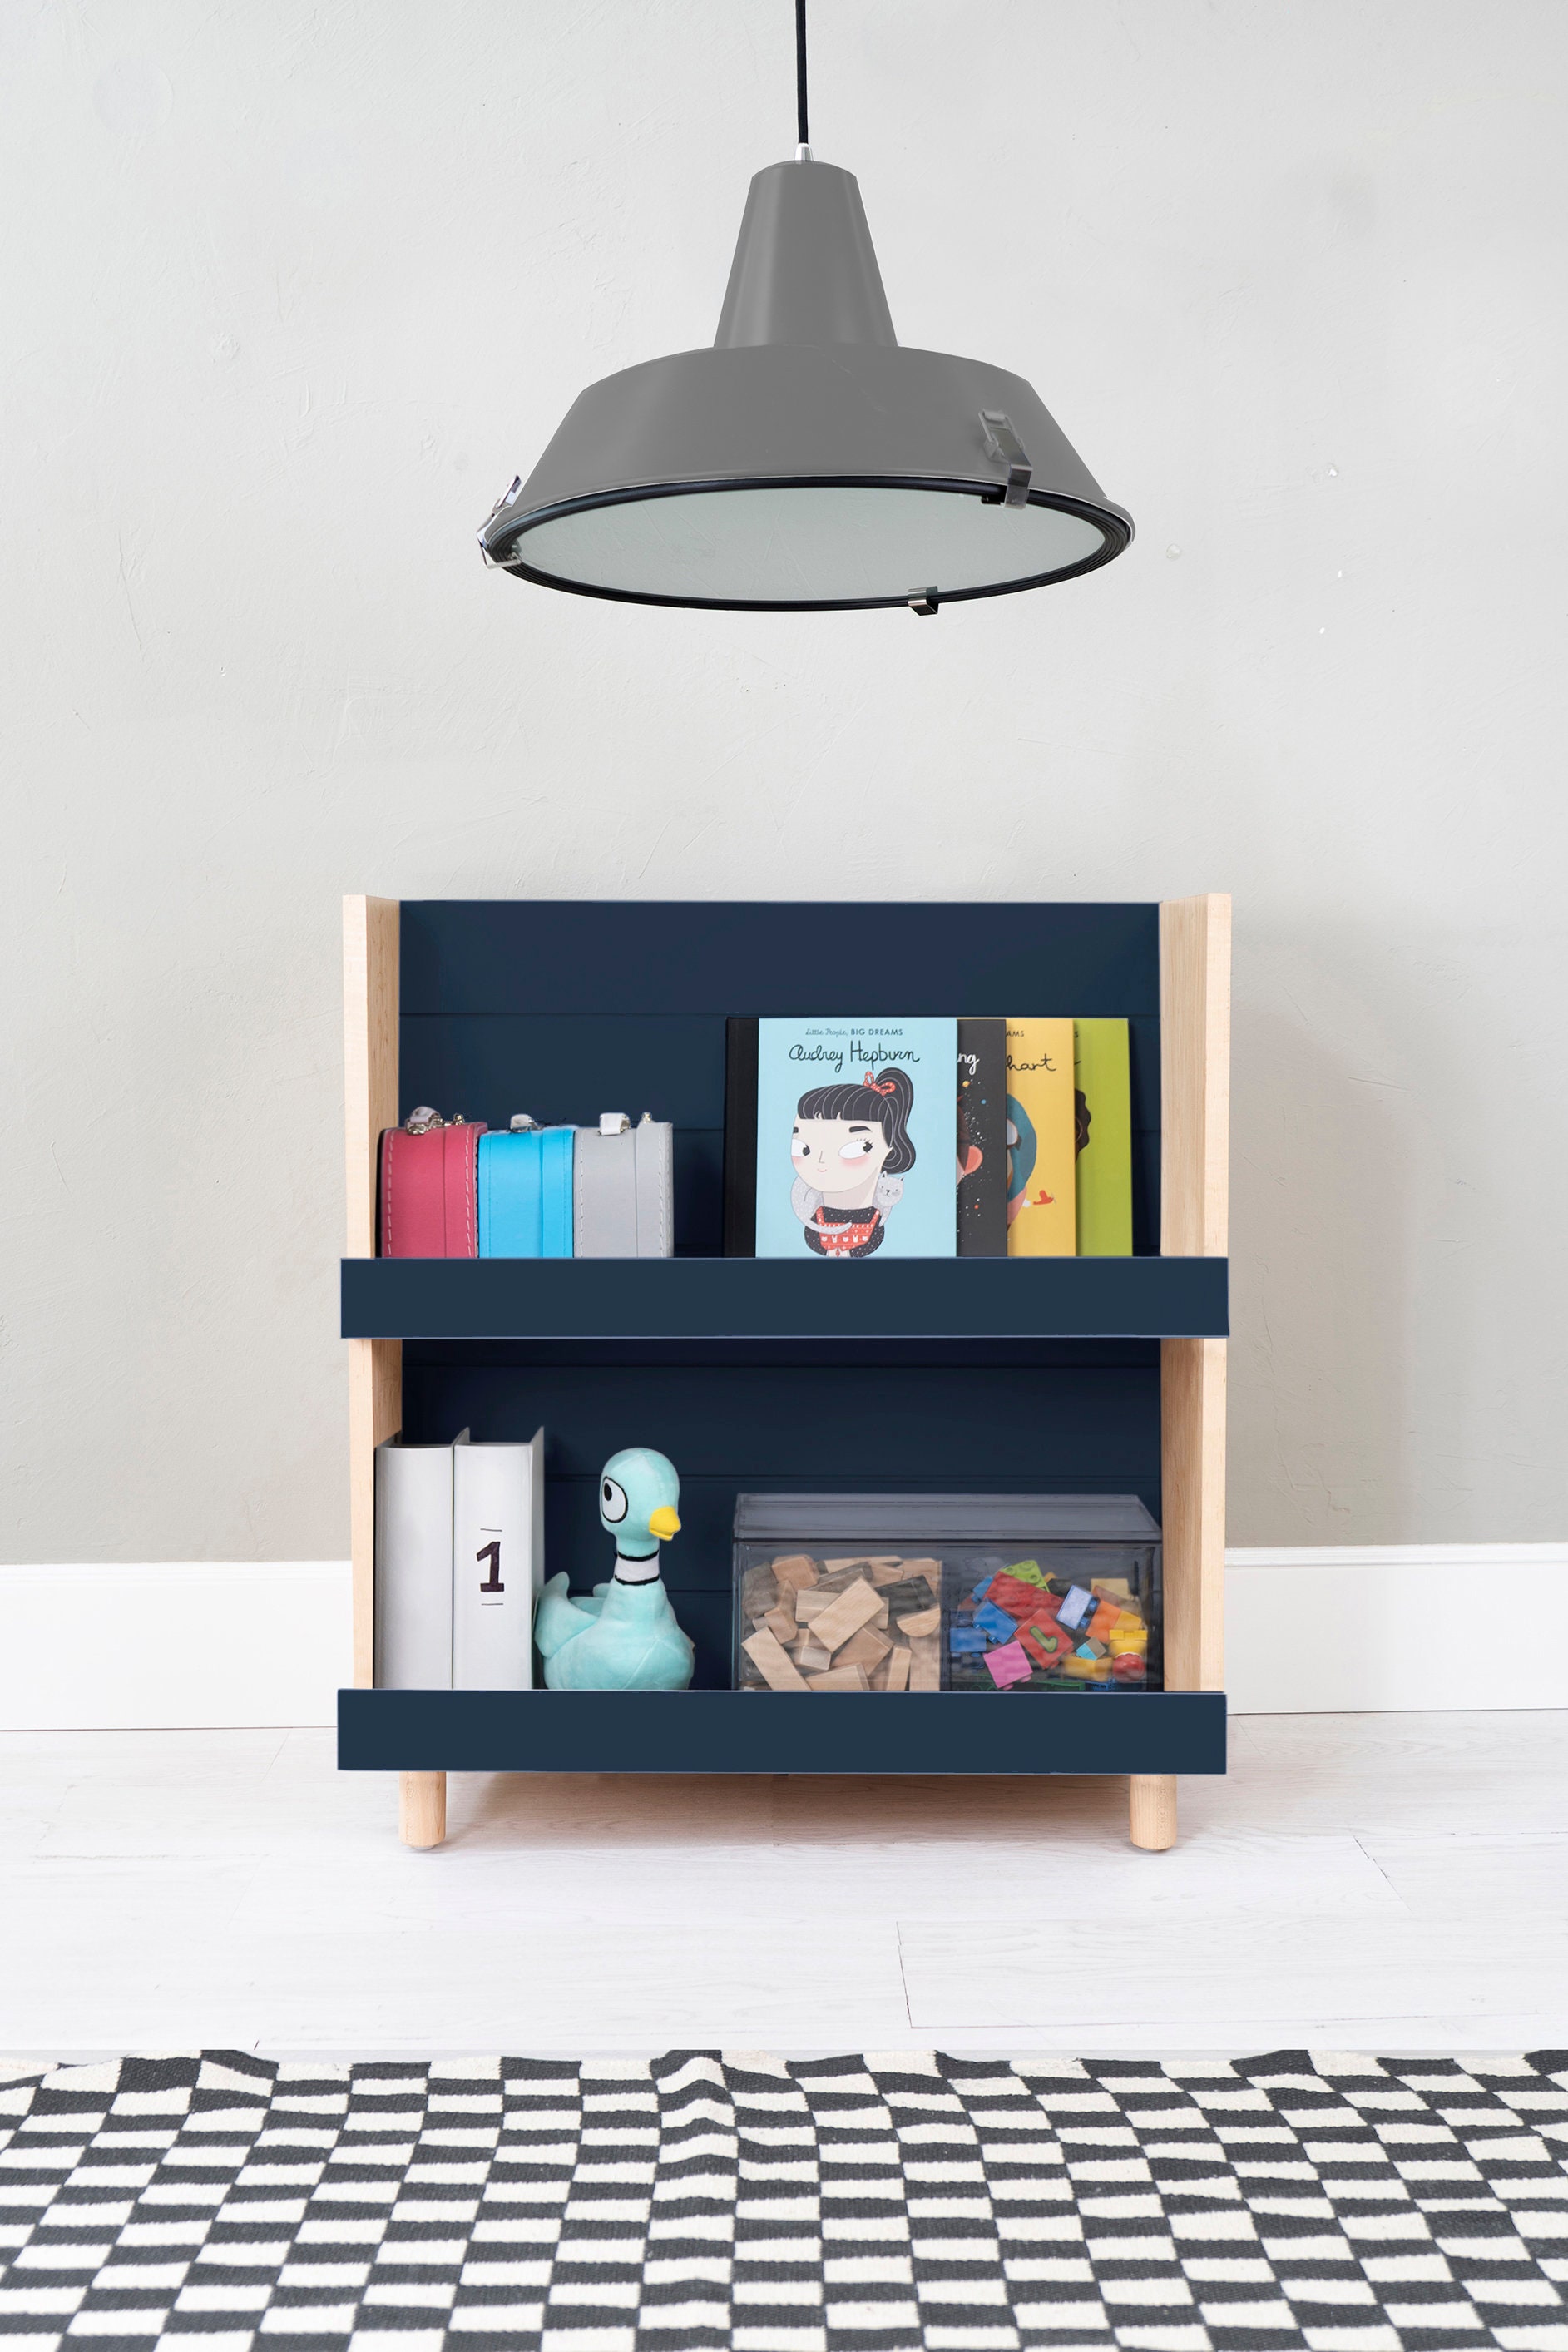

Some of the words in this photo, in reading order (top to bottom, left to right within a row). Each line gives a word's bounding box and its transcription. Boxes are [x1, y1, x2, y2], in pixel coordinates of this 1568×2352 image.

[789, 1043, 843, 1073] Audrey
[850, 1040, 921, 1071] Hepburn
[957, 1052, 981, 1075] ng
[1006, 1053, 1056, 1072] hart
[476, 1541, 505, 1592] 1
